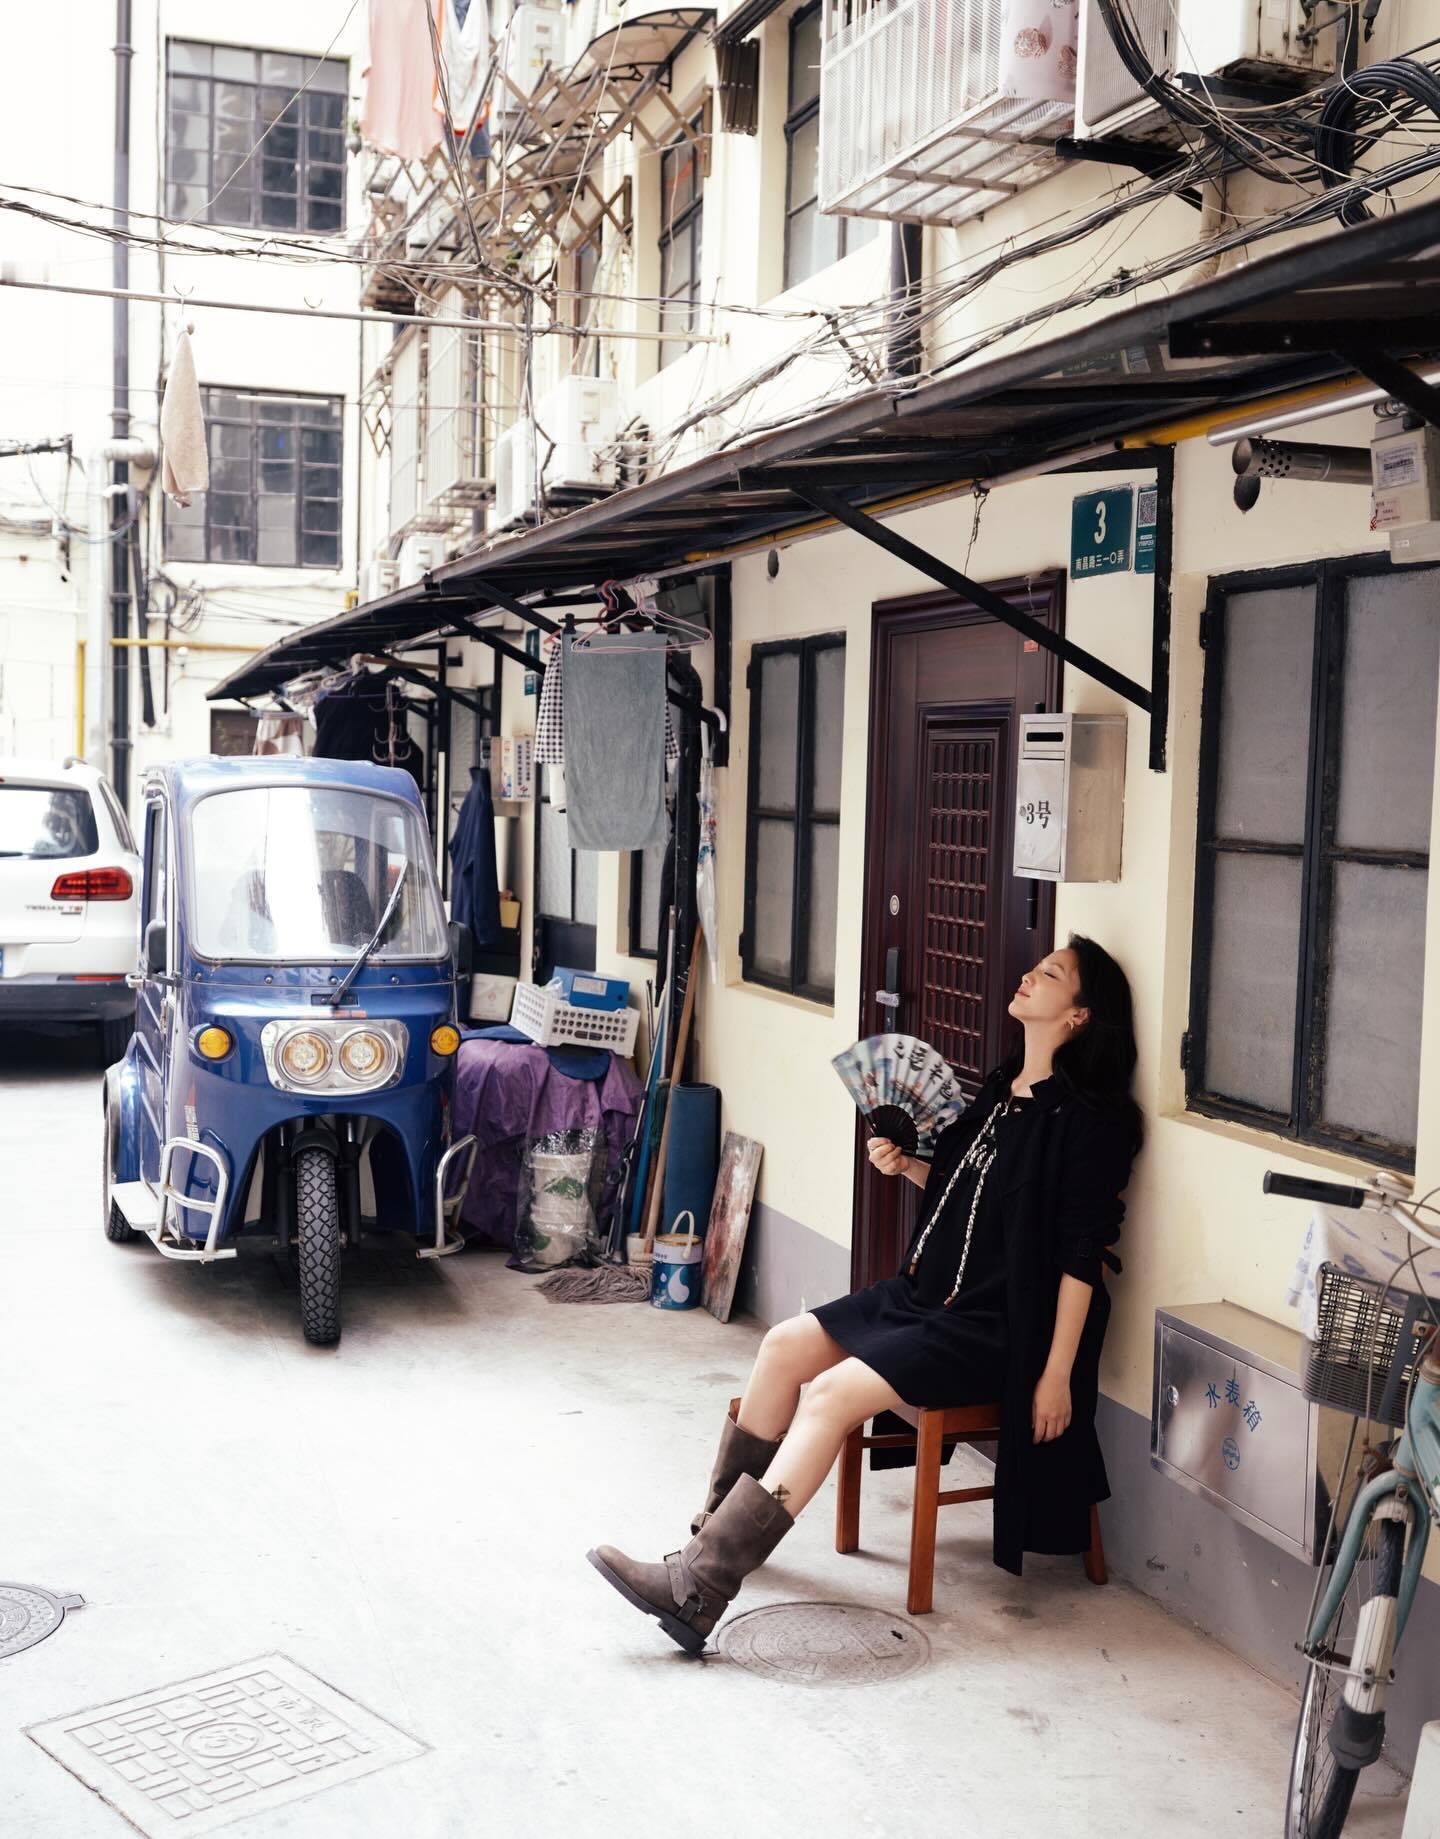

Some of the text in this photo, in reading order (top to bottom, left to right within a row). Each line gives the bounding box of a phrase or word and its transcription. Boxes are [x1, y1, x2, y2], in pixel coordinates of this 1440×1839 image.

[1094, 501, 1106, 544] 3
[1026, 800, 1052, 830] 3号
[1205, 1379, 1262, 1432] 水表箱
